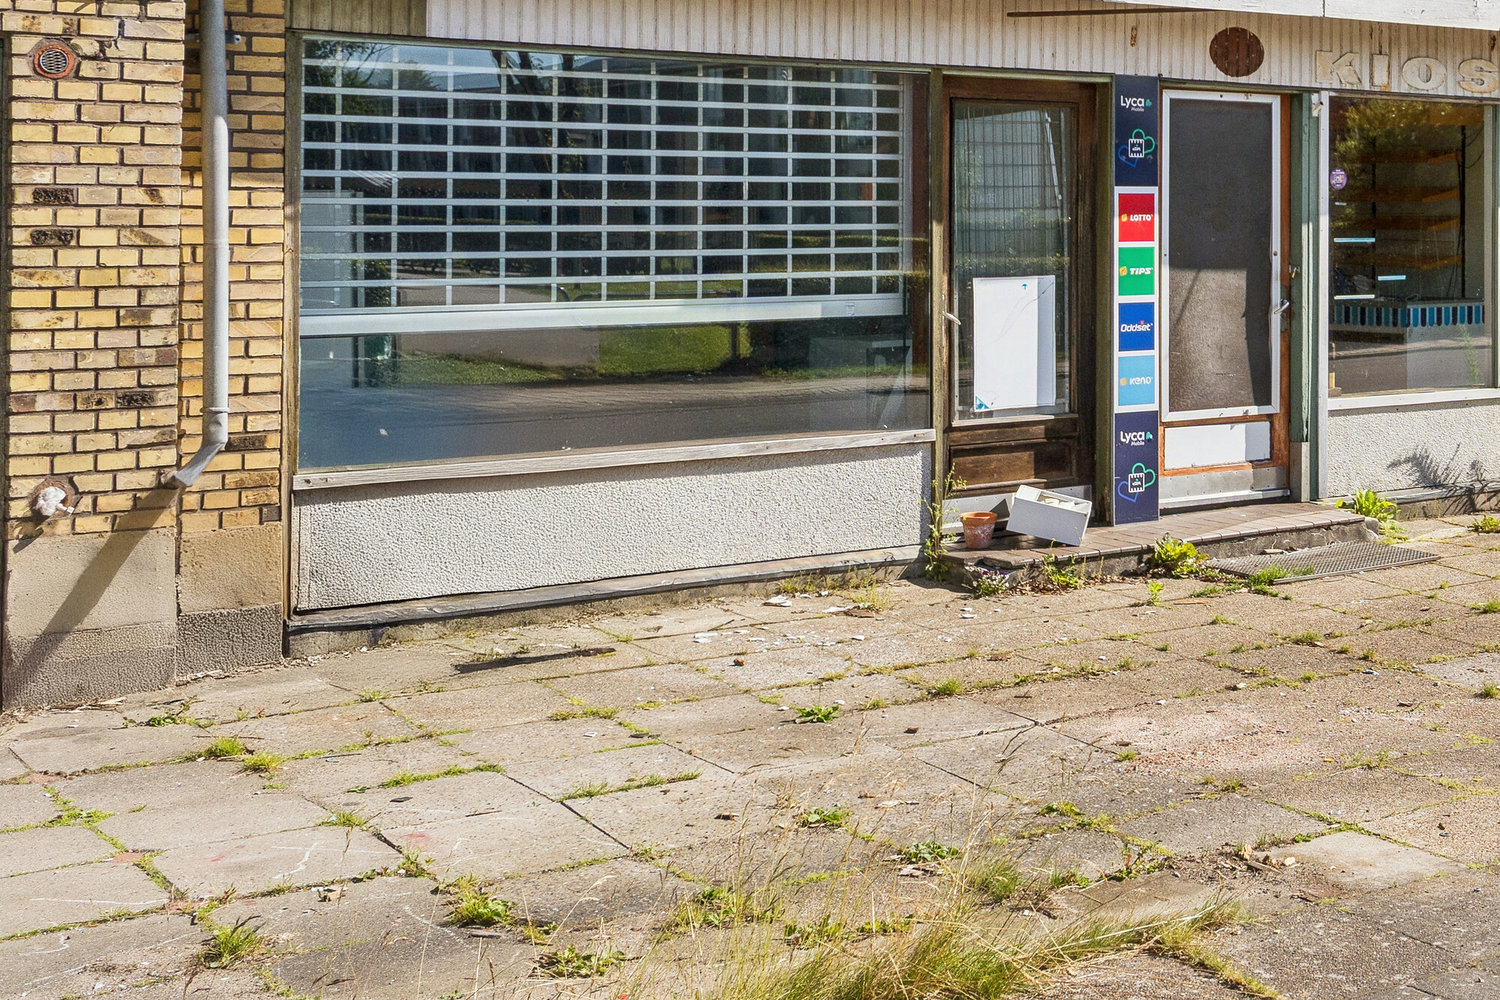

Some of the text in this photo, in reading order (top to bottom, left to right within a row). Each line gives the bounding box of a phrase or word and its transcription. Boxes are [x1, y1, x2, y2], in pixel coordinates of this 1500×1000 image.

[1120, 95, 1145, 109] Lyca
[1129, 214, 1152, 222] LOTTO
[1129, 267, 1152, 275] TIPS
[1120, 323, 1151, 333] Oddset
[1120, 430, 1145, 444] Lyca
